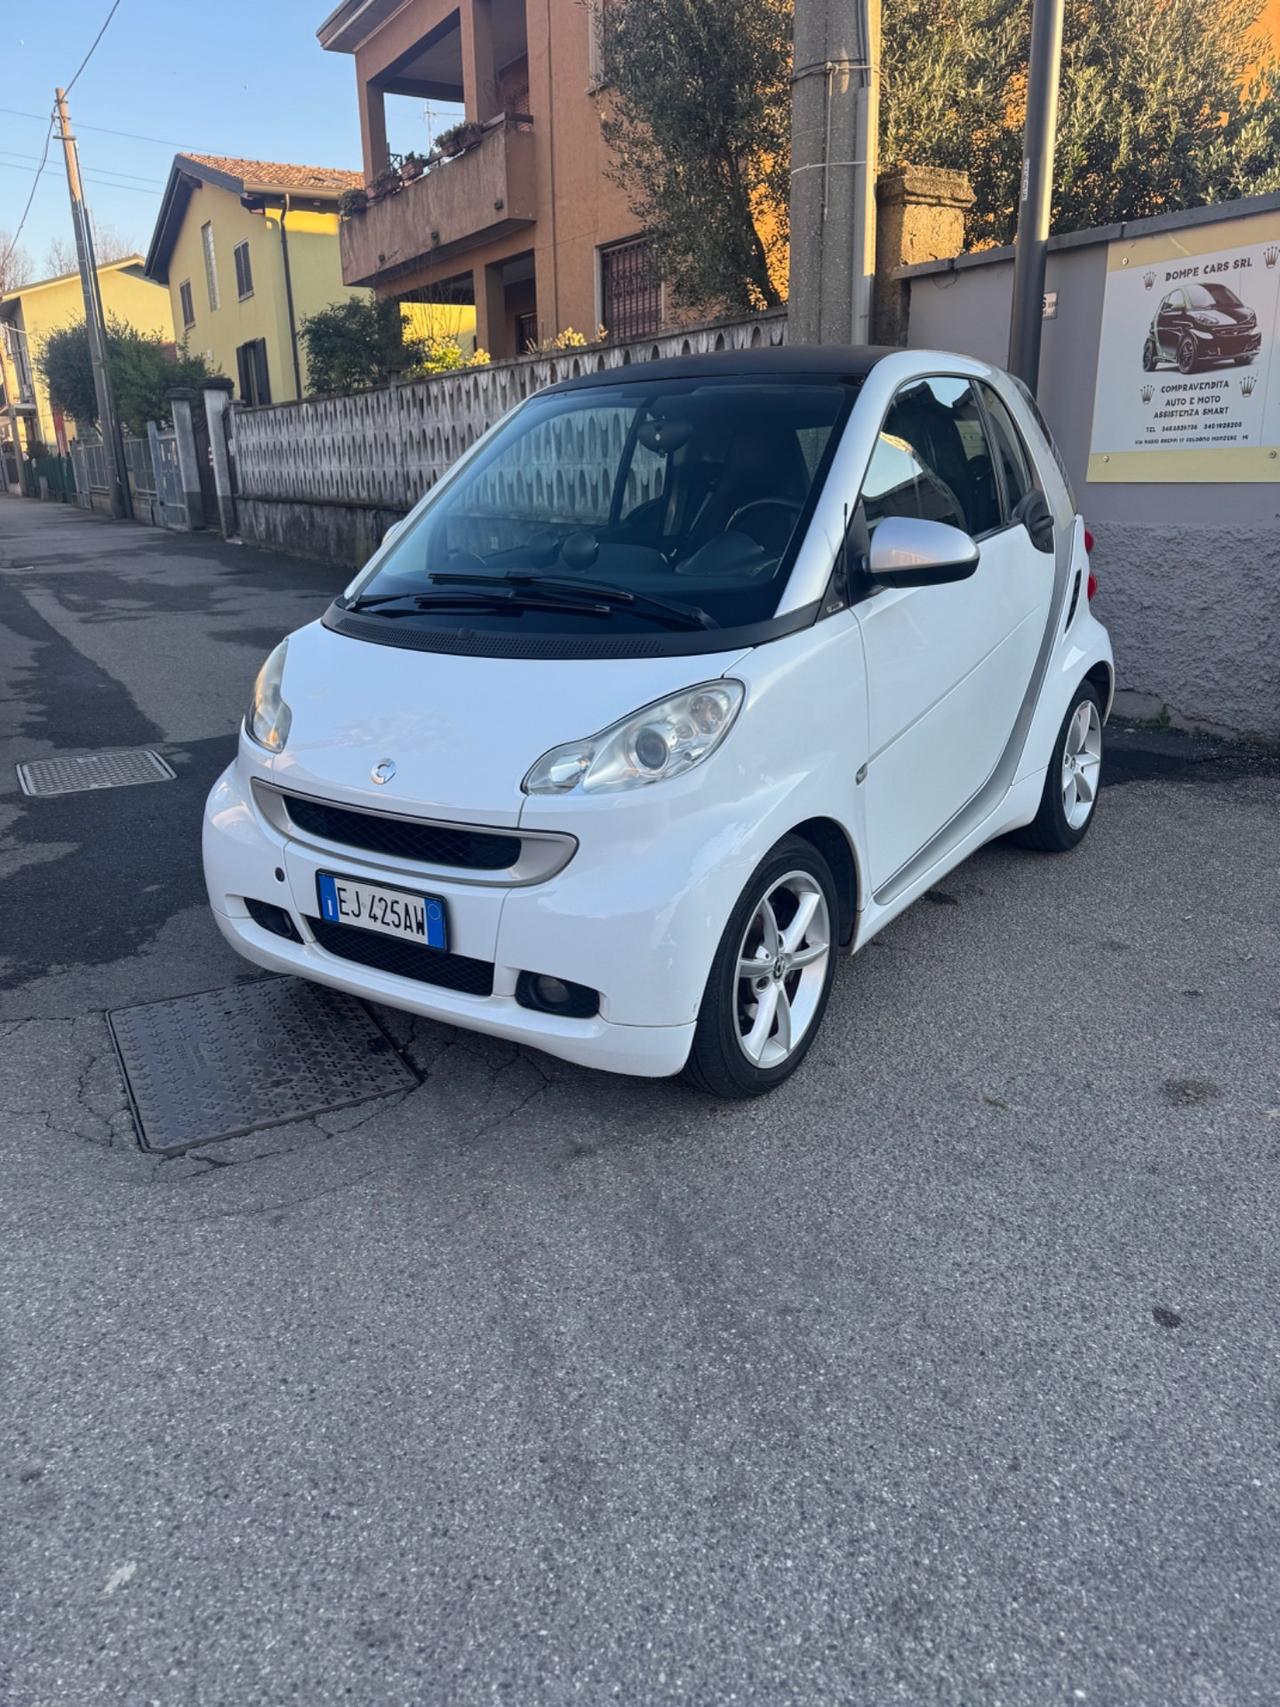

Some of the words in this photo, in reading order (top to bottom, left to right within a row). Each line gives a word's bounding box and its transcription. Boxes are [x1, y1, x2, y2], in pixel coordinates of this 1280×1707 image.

[1165, 267, 1199, 282] DOMPE
[1203, 261, 1230, 275] CARS
[1232, 257, 1253, 269] SRL
[1160, 379, 1230, 393] COMPRAVENDITA
[1165, 398, 1186, 407] AUTO
[1189, 397, 1195, 405] E
[1197, 395, 1221, 404] MOTO
[1153, 409, 1200, 419] ASSISTENZA
[1203, 406, 1230, 416] SMART
[337, 886, 361, 918] EJ
[368, 894, 425, 936] 425AW
